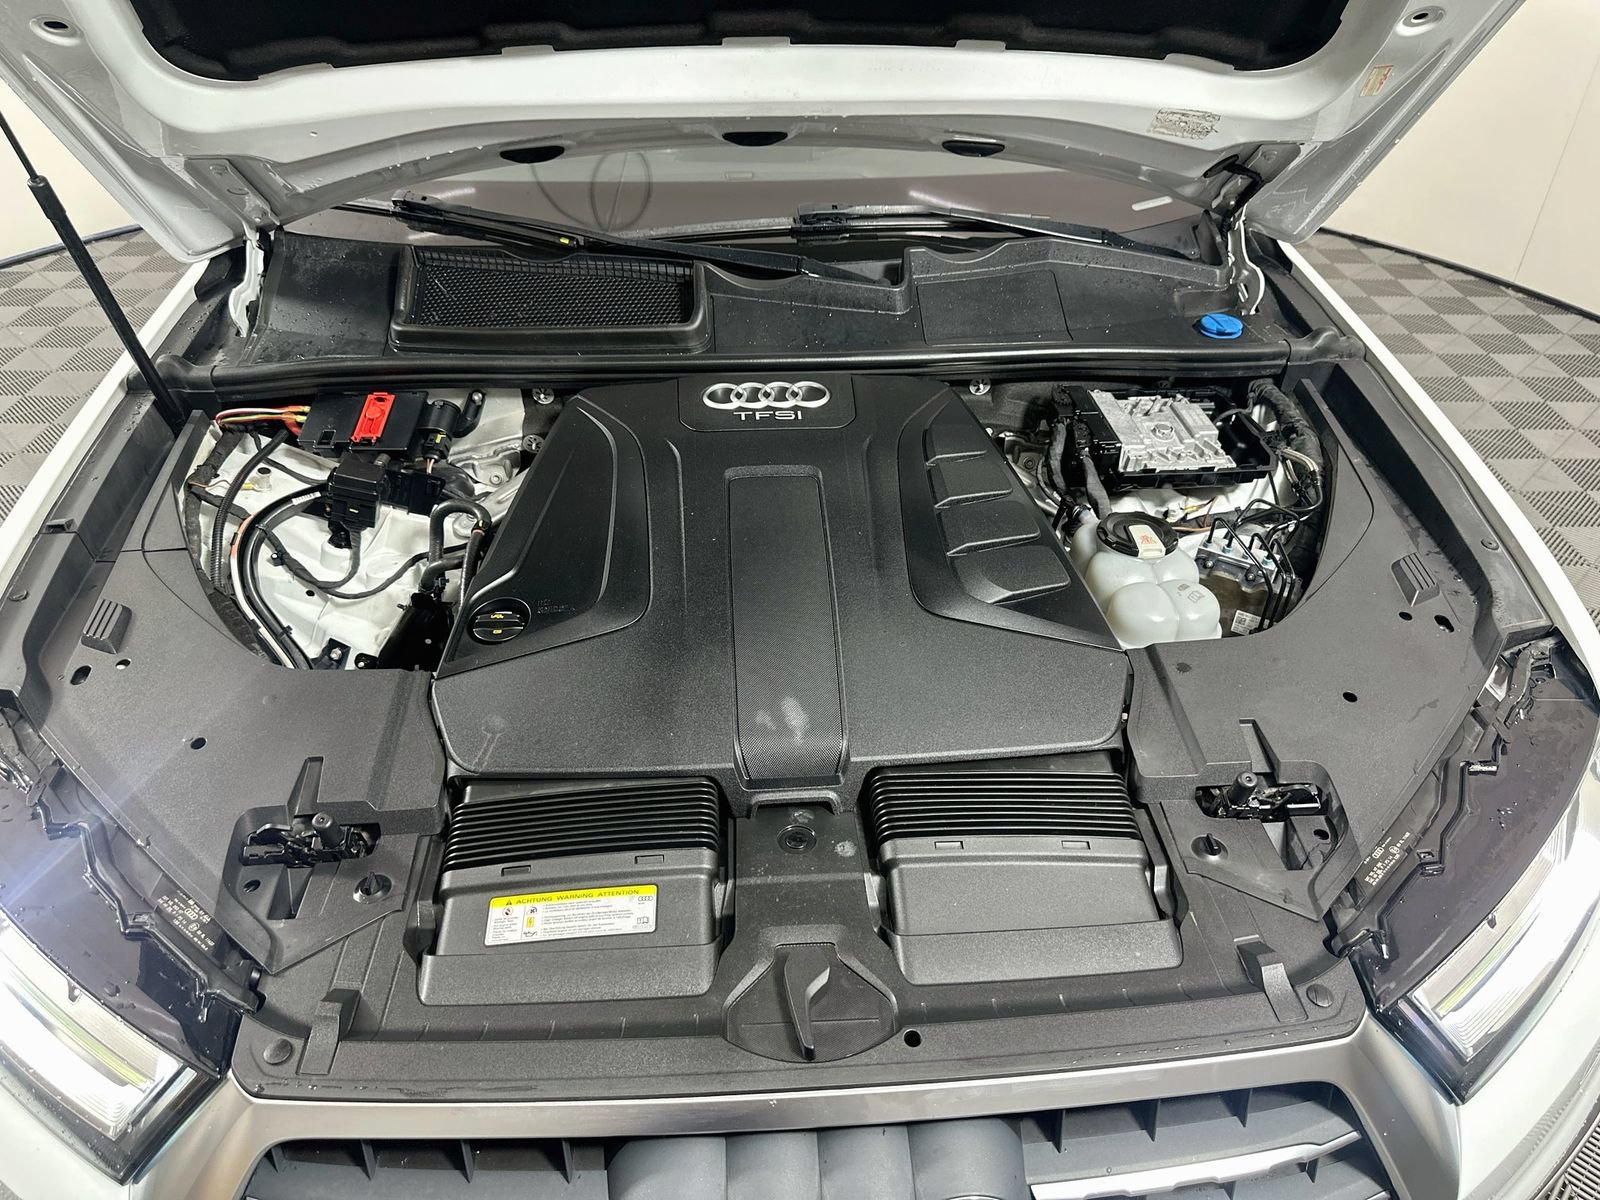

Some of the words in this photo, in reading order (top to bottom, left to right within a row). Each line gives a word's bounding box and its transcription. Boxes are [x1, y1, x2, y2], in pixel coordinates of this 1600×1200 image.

[733, 410, 802, 420] TFSI
[516, 896, 553, 905] ACHTUNG
[556, 892, 593, 901] WARNING
[597, 889, 639, 898] ATTENTION
